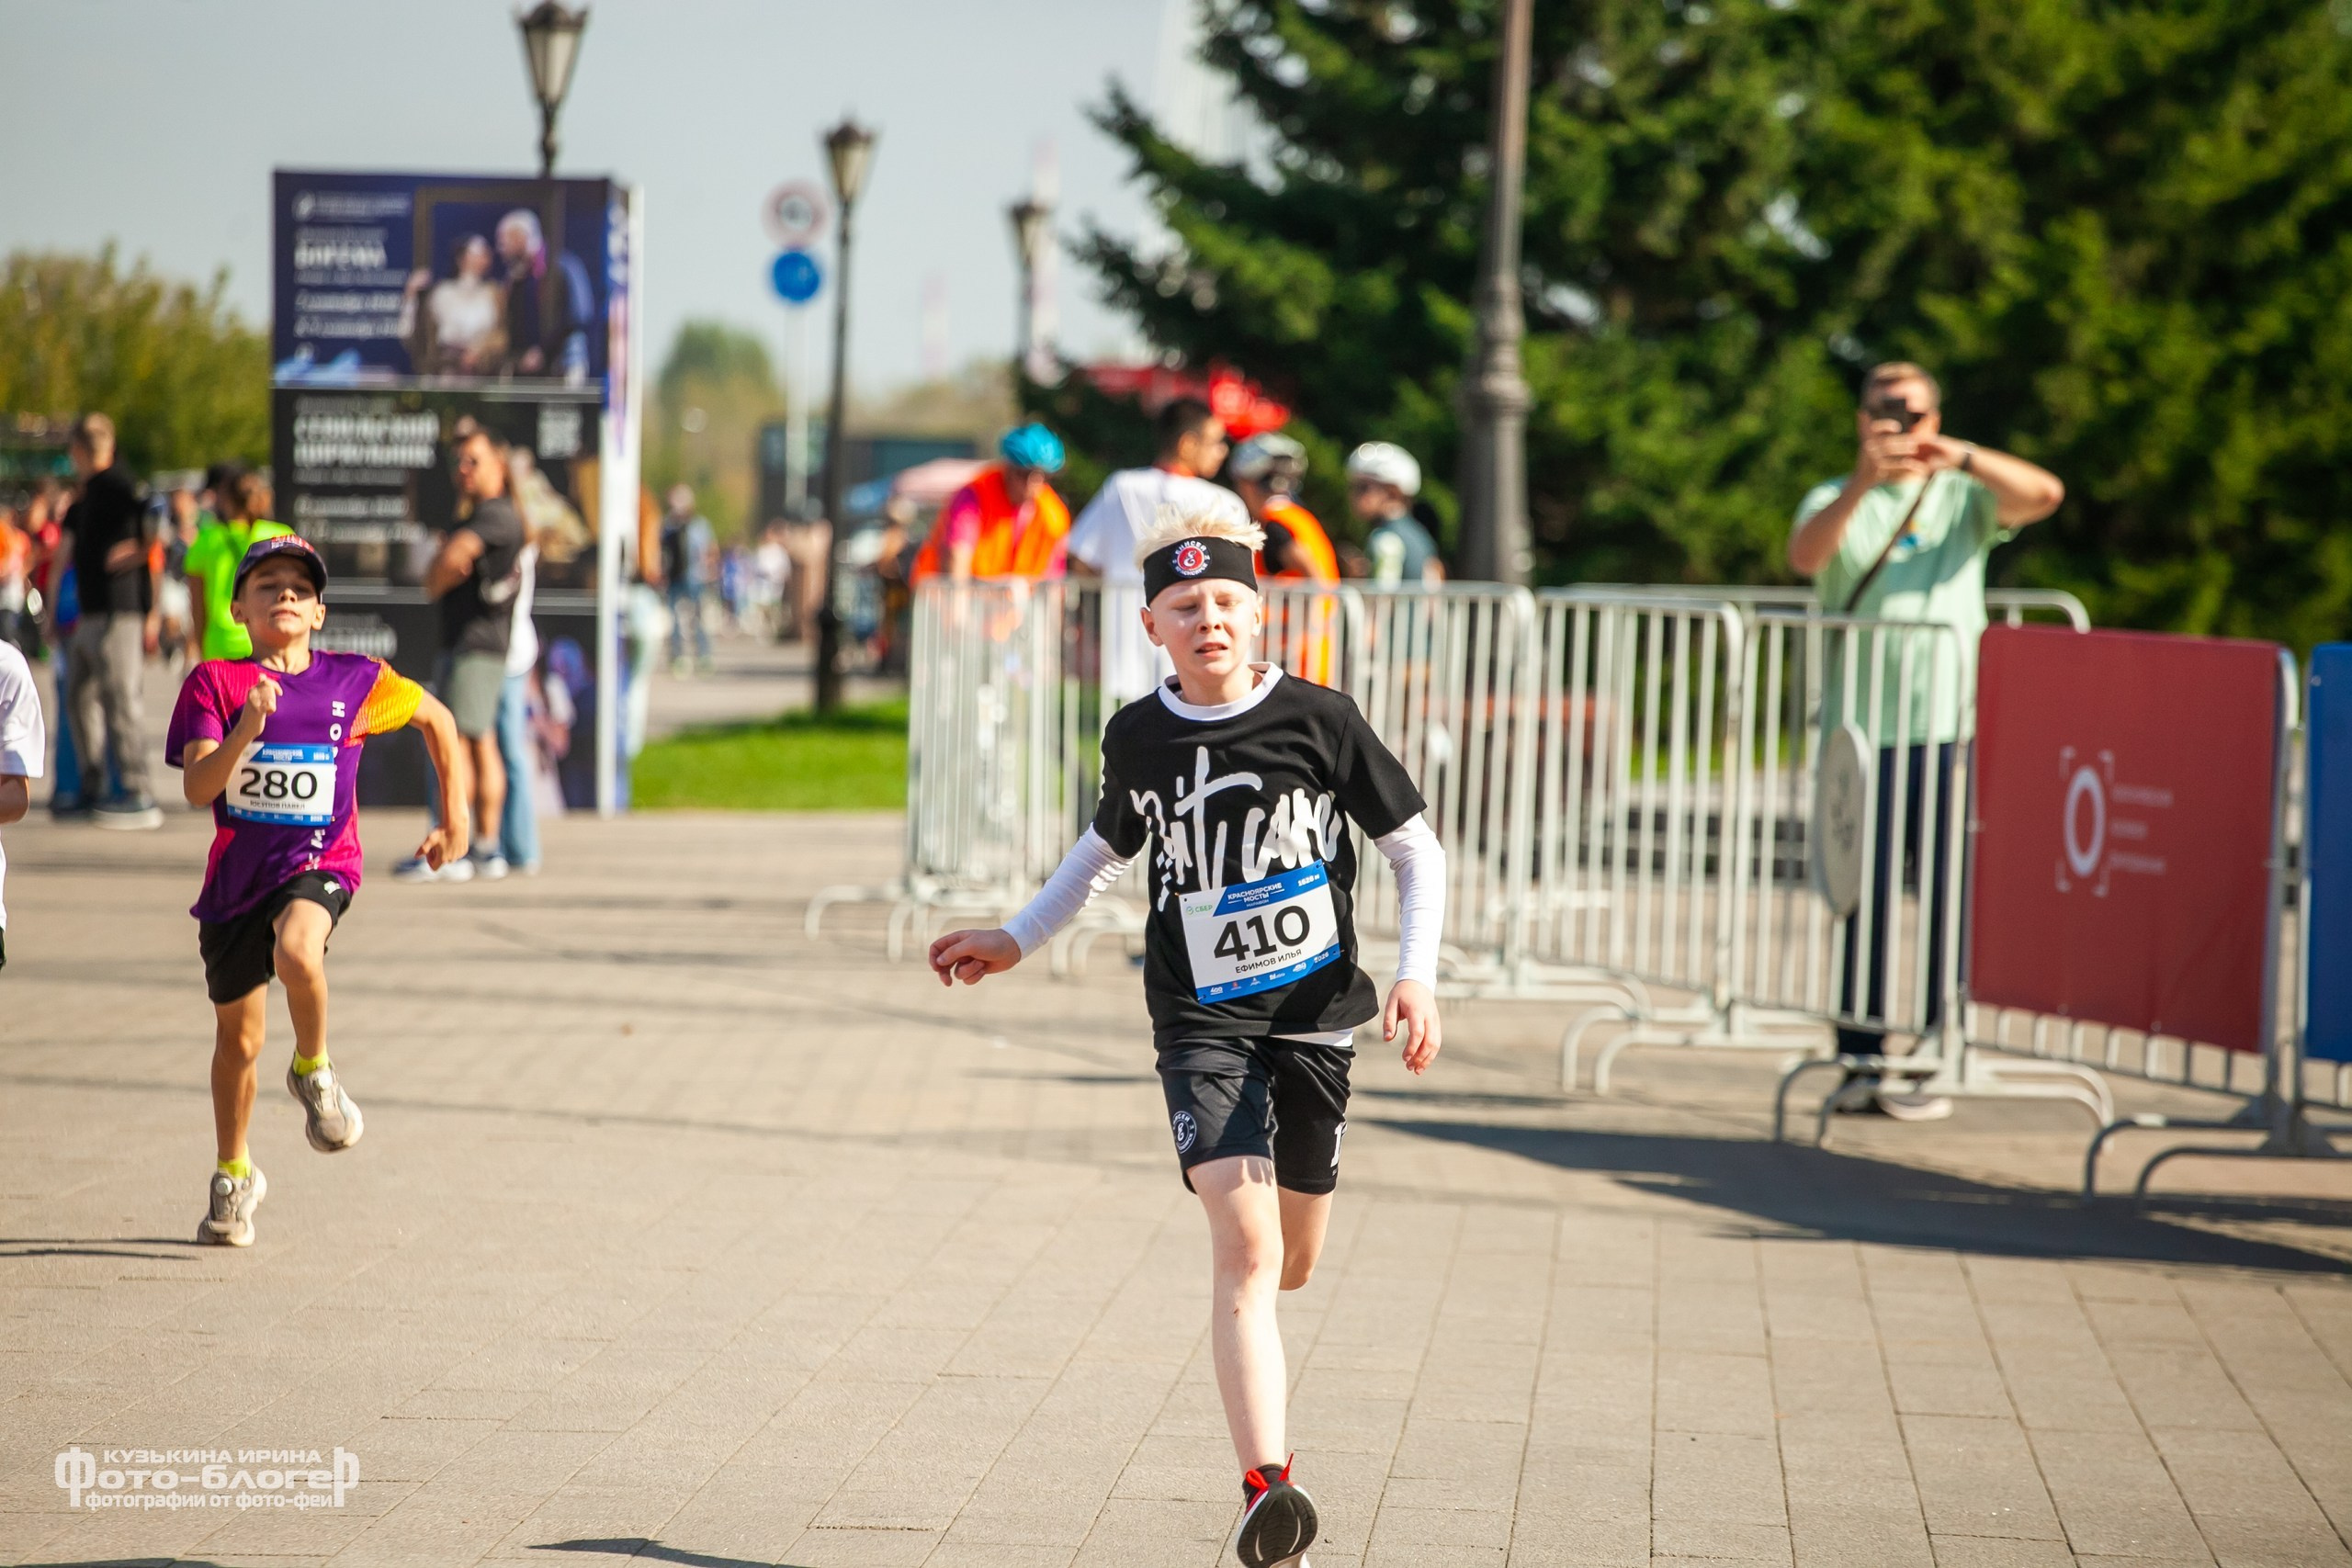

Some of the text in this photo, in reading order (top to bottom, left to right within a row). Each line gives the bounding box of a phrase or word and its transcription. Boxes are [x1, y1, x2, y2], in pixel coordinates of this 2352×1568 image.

[240, 768, 318, 799] 280
[1227, 882, 1283, 900] КРАСНОЯРСКИЕ
[1244, 893, 1270, 903] МОСТЫ
[1194, 904, 1213, 913] СБЕР
[1213, 905, 1311, 962] 410
[1235, 949, 1303, 974] ЕФИМОВ ИЛЬЯ
